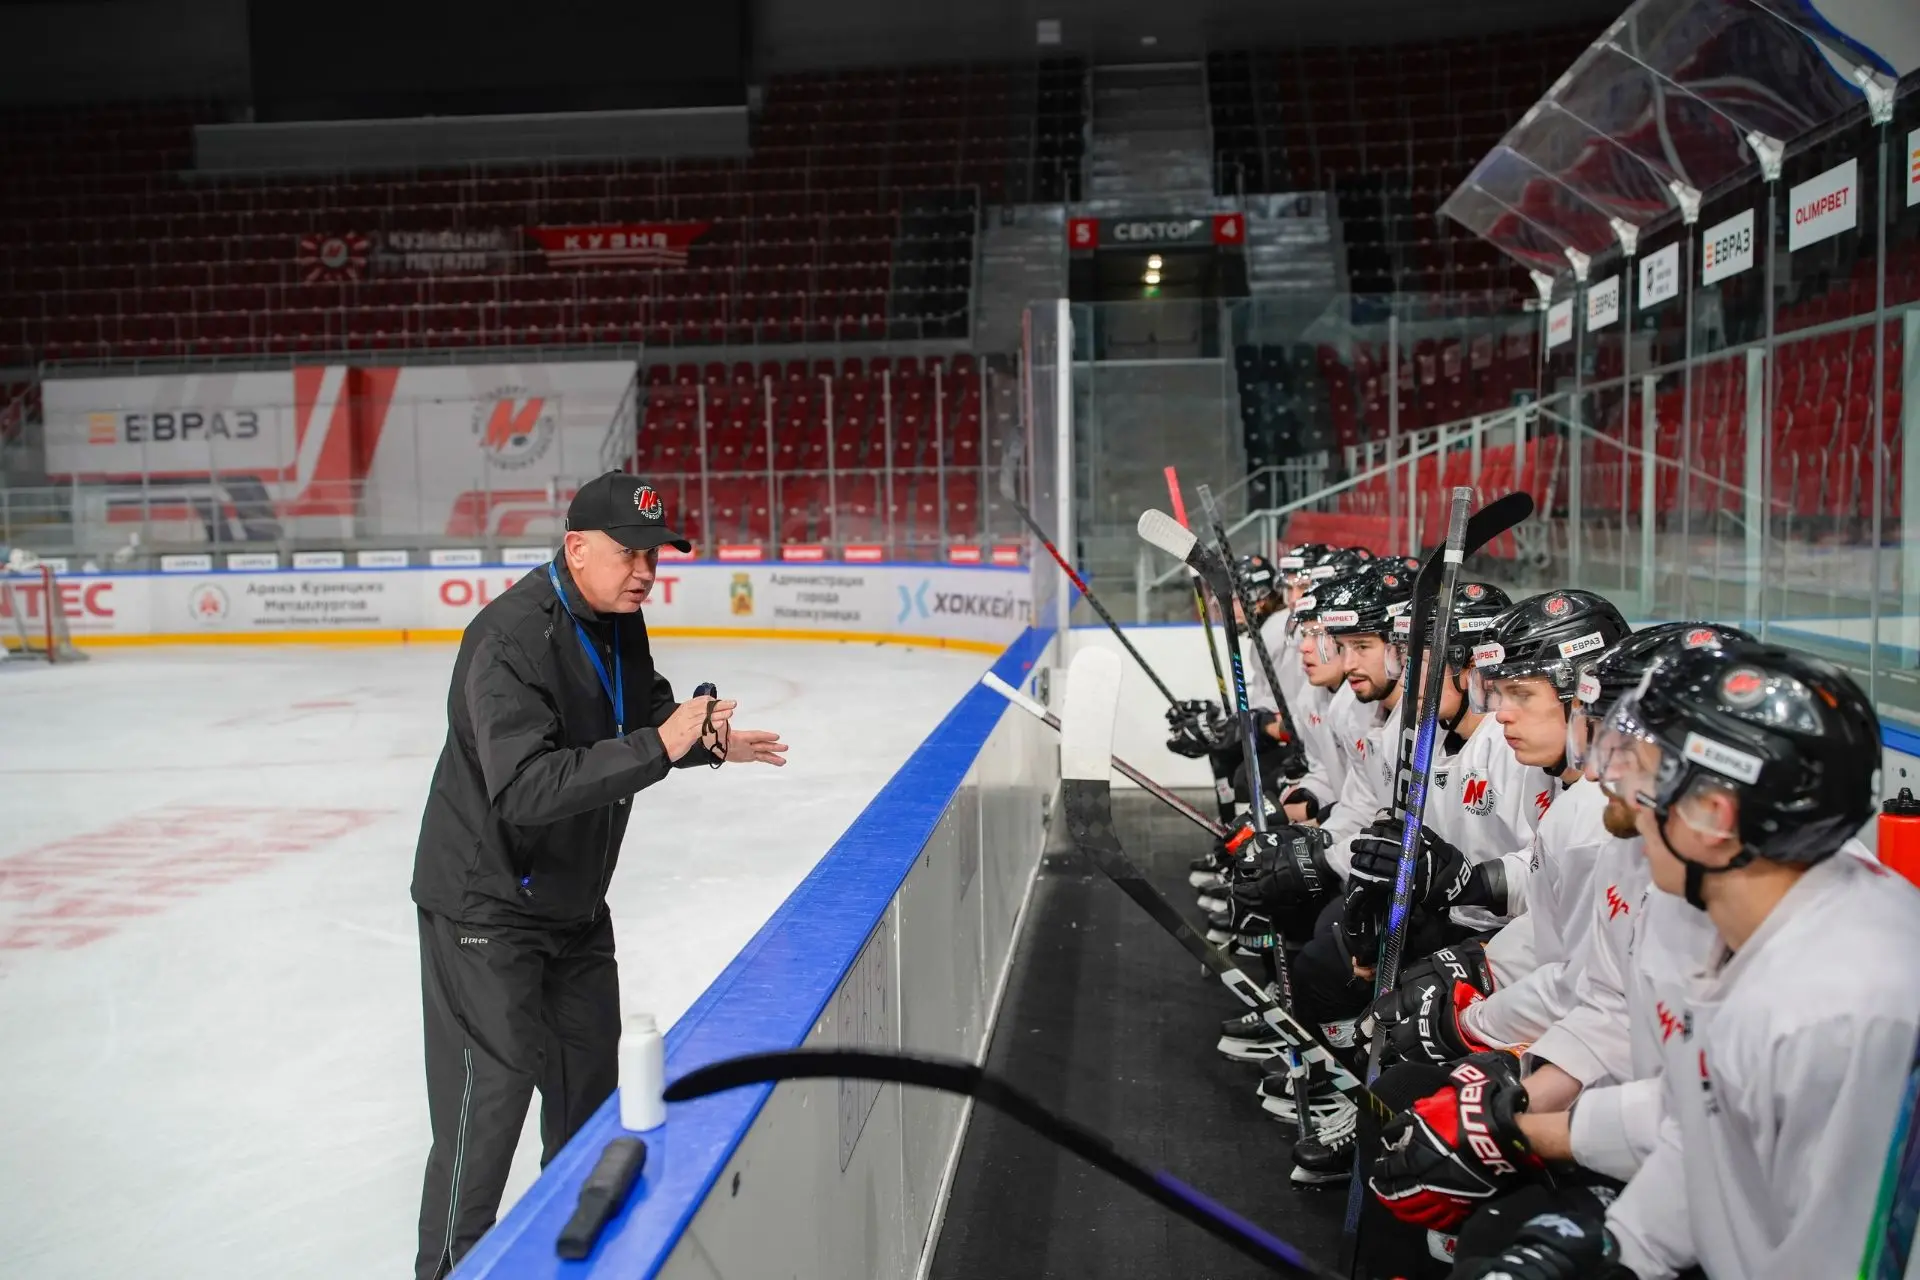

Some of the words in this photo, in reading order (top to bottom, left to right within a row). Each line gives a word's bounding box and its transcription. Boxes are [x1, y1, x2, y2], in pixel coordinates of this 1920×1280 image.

[1795, 187, 1849, 225] OLIMPBET
[1076, 223, 1090, 243] 5
[1220, 219, 1237, 238] 4
[1715, 228, 1750, 265] ЕВРАЗ
[125, 410, 260, 443] ЕВРАЗ
[934, 590, 1014, 619] ХОККЕЙ
[1573, 637, 1601, 651] ЕВРАЗ
[1233, 653, 1249, 712] FLYLITE
[1704, 747, 1752, 774] ЕВРАЗ
